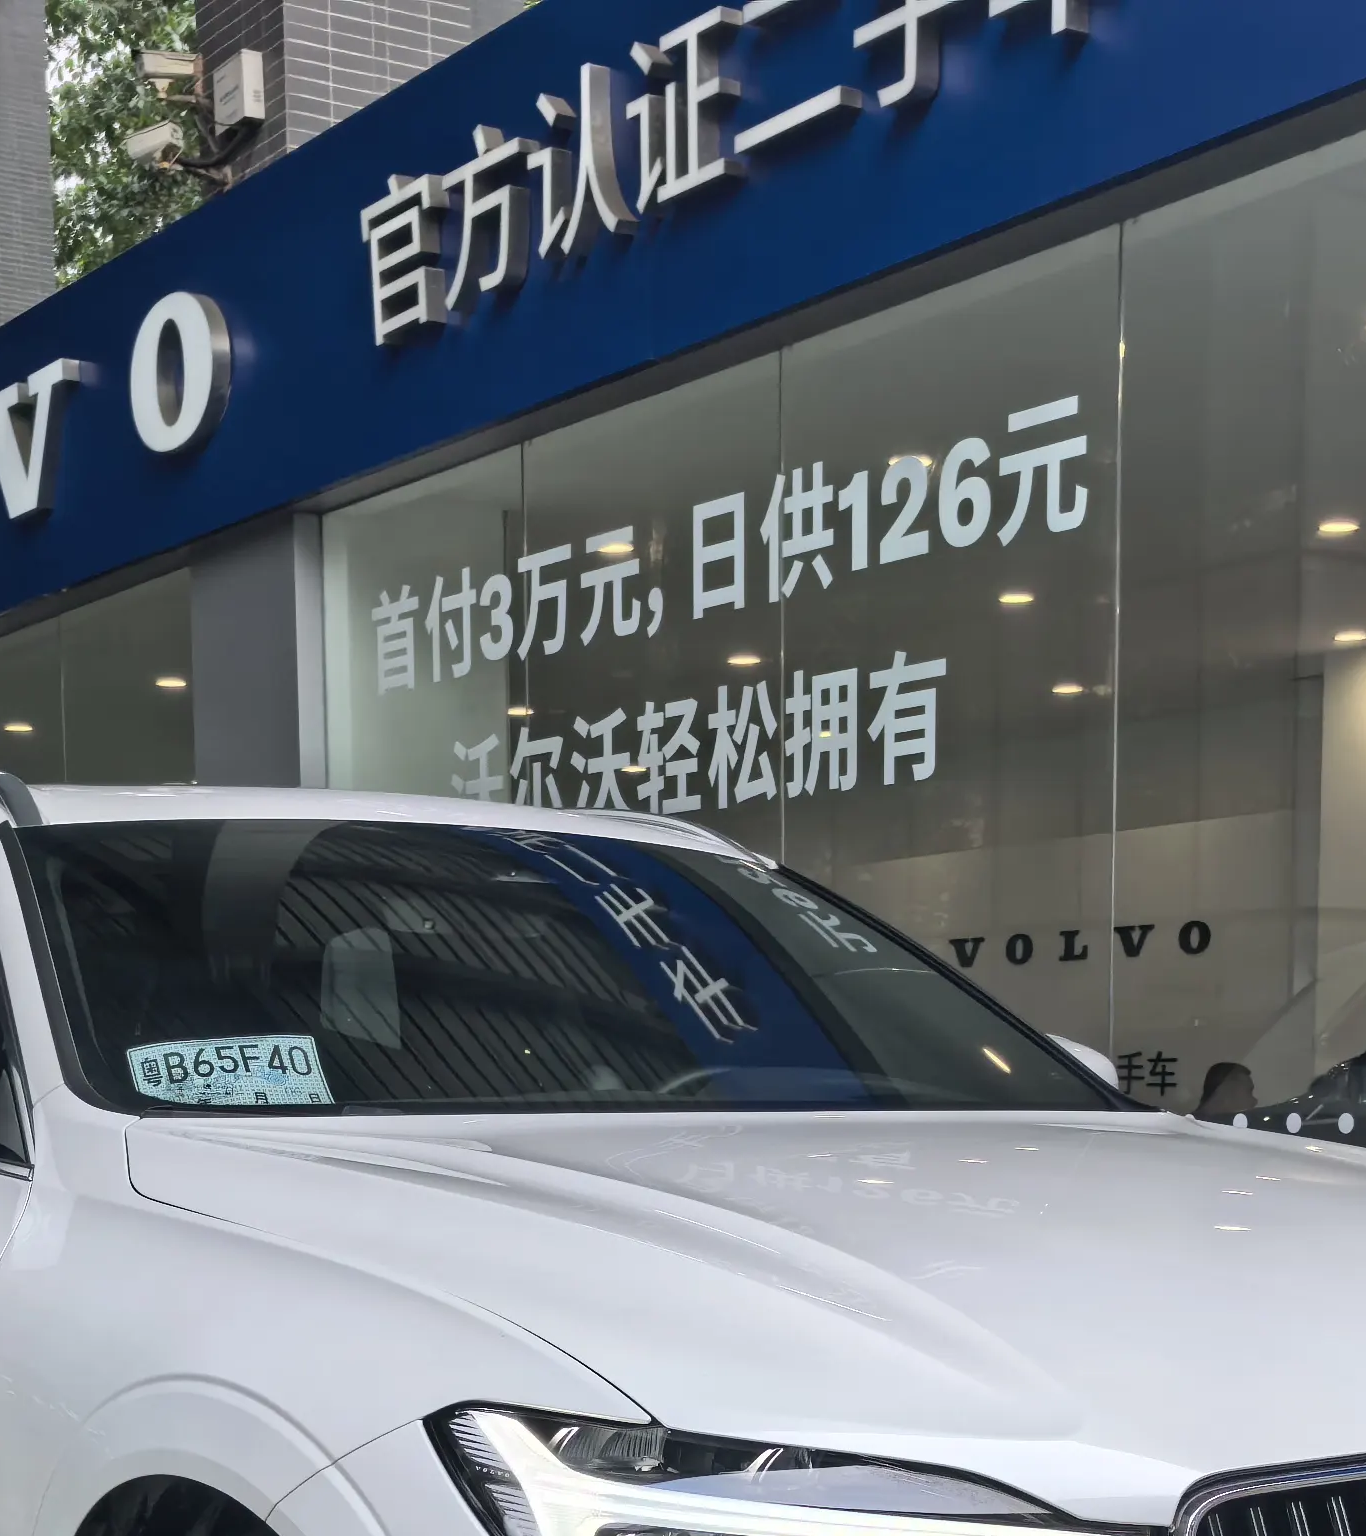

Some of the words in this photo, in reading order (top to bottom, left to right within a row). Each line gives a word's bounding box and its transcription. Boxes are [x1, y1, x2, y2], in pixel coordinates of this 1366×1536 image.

[360, 0, 1088, 347] 官方认证二
[949, 920, 1212, 968] VOLVO
[475, 1465, 510, 1478] VOLVO
